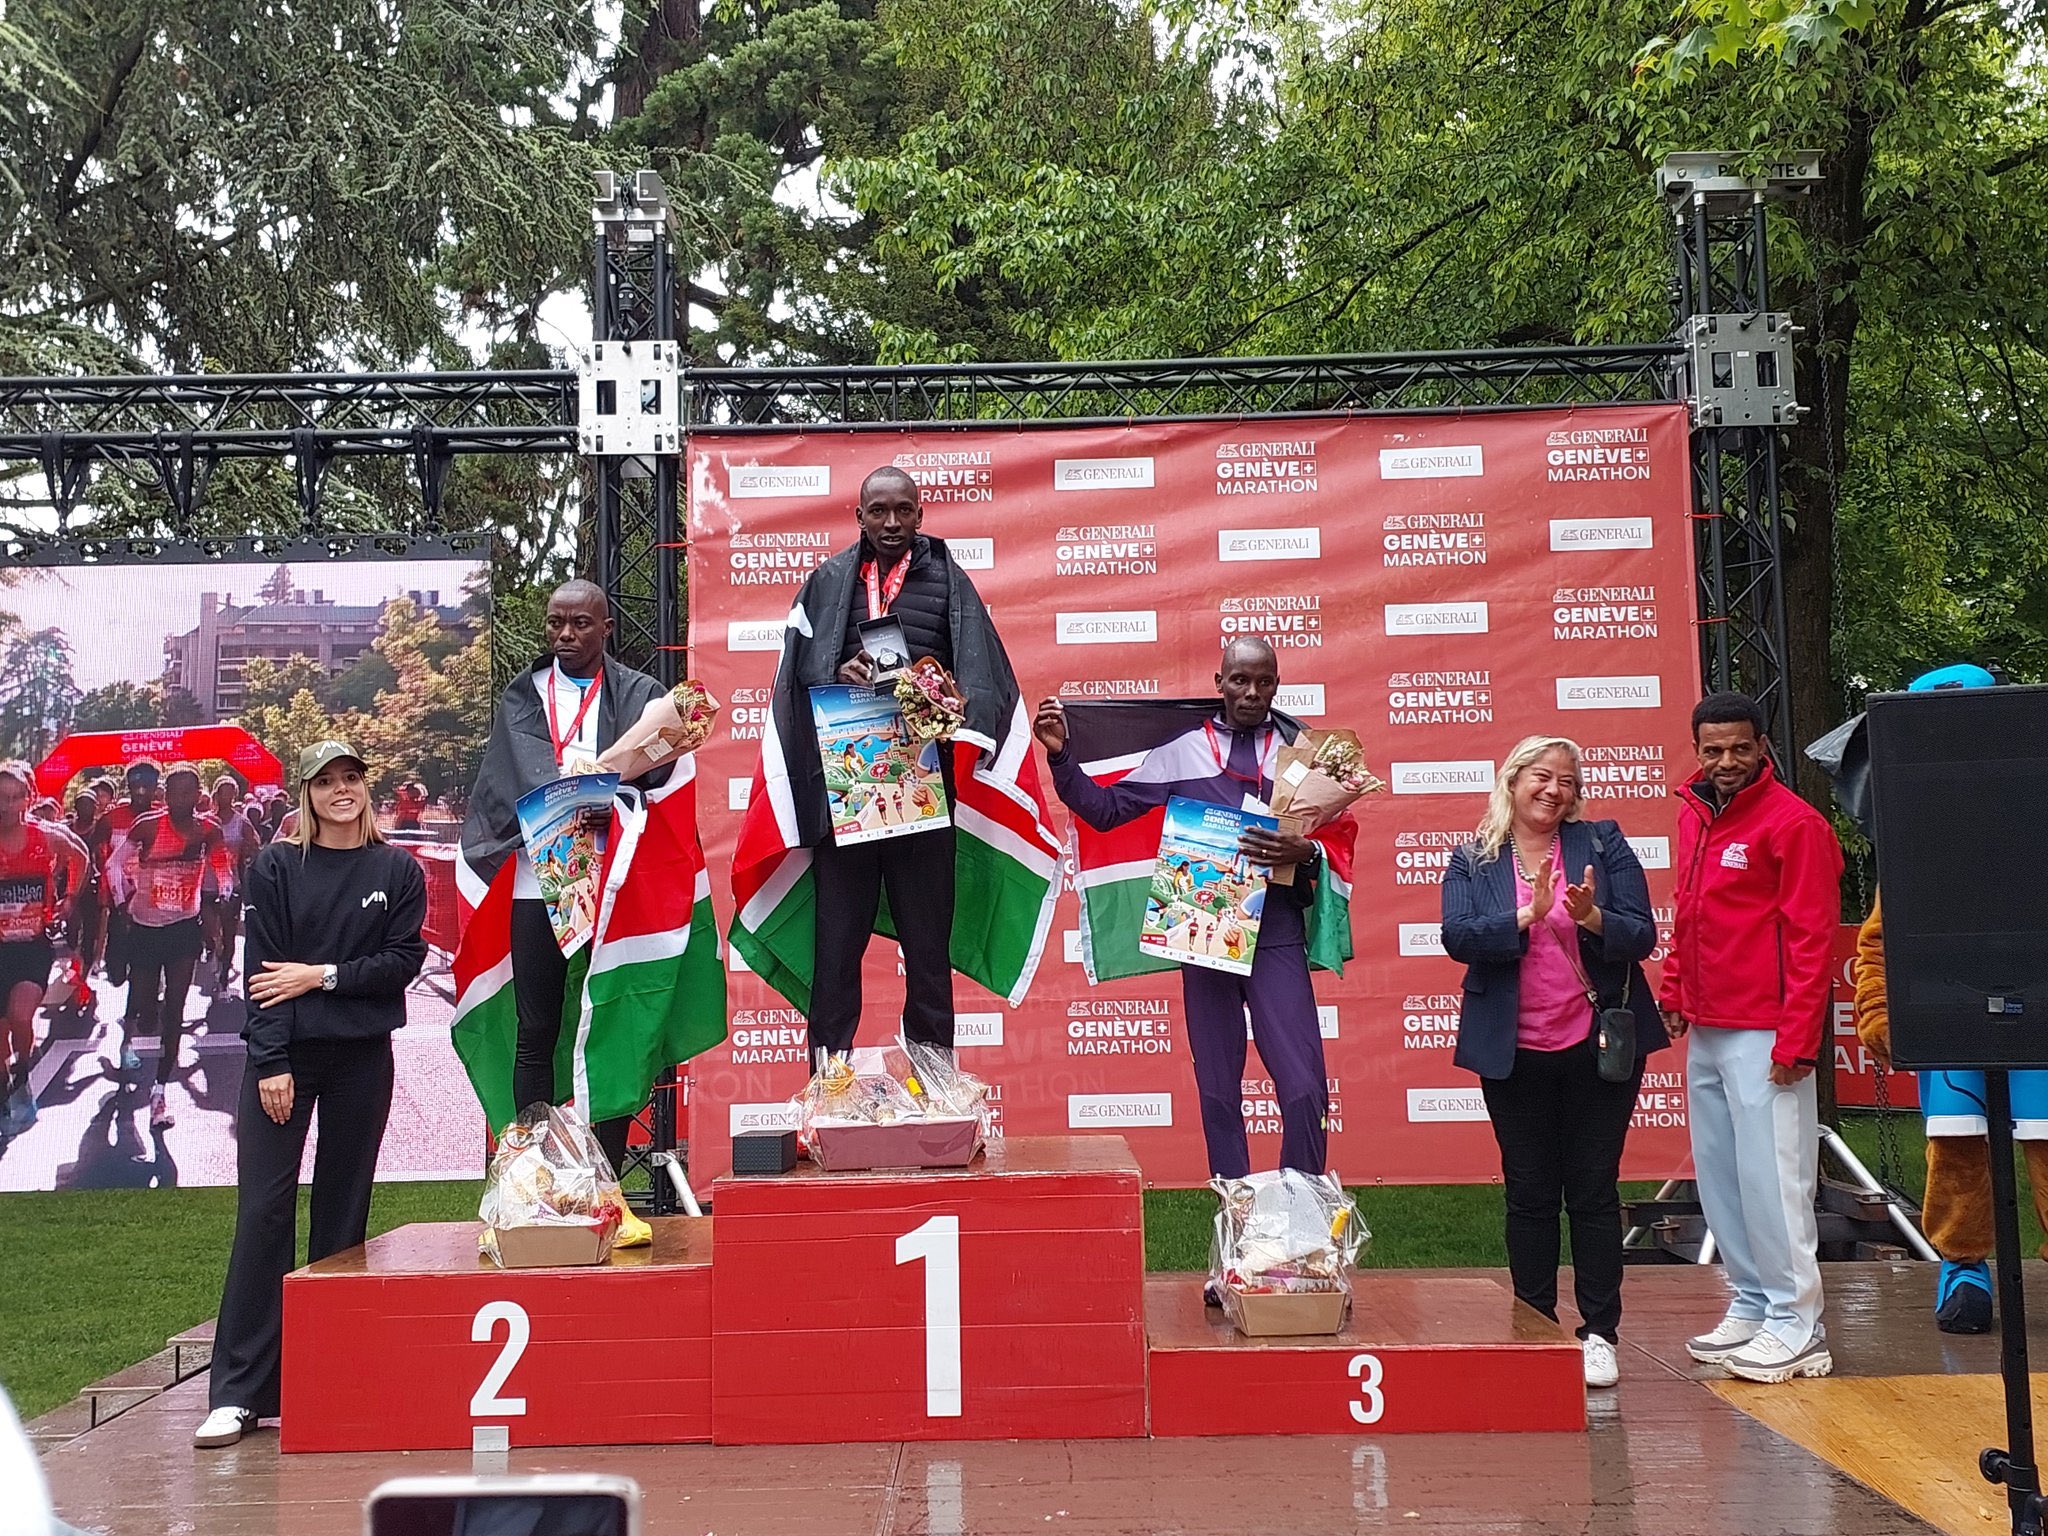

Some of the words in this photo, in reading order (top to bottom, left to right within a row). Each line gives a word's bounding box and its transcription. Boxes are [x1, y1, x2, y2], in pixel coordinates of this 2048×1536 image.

[1570, 427, 1648, 443] GENERALI
[1240, 441, 1315, 457] GENERALI
[1547, 444, 1632, 466] GENÈVE
[916, 451, 991, 467] GENERALI
[1410, 455, 1472, 469] GENERALI
[911, 467, 976, 486] ENÈVE
[1083, 467, 1144, 480] GENERALI
[1216, 458, 1300, 479] GENÈVE
[1548, 465, 1650, 482] MARATHON
[759, 475, 820, 488] GENERALI
[1216, 479, 1318, 495] MARATHON
[920, 488, 993, 503] RATHON
[1407, 513, 1485, 529] GENERALI
[753, 532, 830, 548] GENERALI
[1079, 524, 1155, 541] GENERALI
[1383, 530, 1468, 551] GENÈVE
[1580, 528, 1643, 541] GENERALI
[1056, 540, 1140, 561] GENÈVE
[1248, 537, 1310, 550] GENERALI
[730, 549, 814, 569] GENÈVE
[950, 548, 984, 561] ERALI
[1384, 551, 1487, 568] MARATHON
[1056, 559, 1157, 576] MARATHON
[730, 570, 811, 586] MARATH
[1577, 586, 1655, 602] GENERALI
[1243, 595, 1321, 611] GENERALI
[1415, 611, 1478, 625] GENERALI
[1554, 603, 1639, 624] GENÈVE
[1085, 621, 1147, 634] GENERALI
[1220, 612, 1305, 633] GENÈVE
[1554, 624, 1658, 640] MARATHON
[1412, 671, 1490, 686] GENERALI
[1083, 680, 1160, 697] GENERALI
[1587, 686, 1650, 699] GENERALI
[1272, 694, 1315, 708] NERALI
[1389, 688, 1475, 708] GENÈVE
[1389, 709, 1493, 725] MARATHON
[121, 739, 173, 753] GENÈVE
[1584, 746, 1664, 761] GENERALI
[1421, 770, 1485, 784] GENERALI
[1581, 762, 1648, 782] ENÈVE
[1580, 784, 1667, 800] ARATHON
[1396, 848, 1453, 869] GENÈ
[1396, 871, 1445, 885] MARA
[1091, 1000, 1169, 1015] GENERALI
[1067, 1017, 1153, 1038] GENÈVE
[1403, 1010, 1459, 1032] GENÈ
[732, 1026, 807, 1047] GENÈV
[957, 1023, 993, 1036] ERALI
[1067, 1039, 1171, 1055] MARATHON
[1404, 1034, 1457, 1049] MARA
[732, 1048, 808, 1064] MARATH
[1098, 1104, 1161, 1118] GENERALI
[1439, 1097, 1483, 1111] GENER
[894, 1216, 962, 1417] 1
[470, 1301, 530, 1417] 2
[1347, 1354, 1386, 1425] 3
